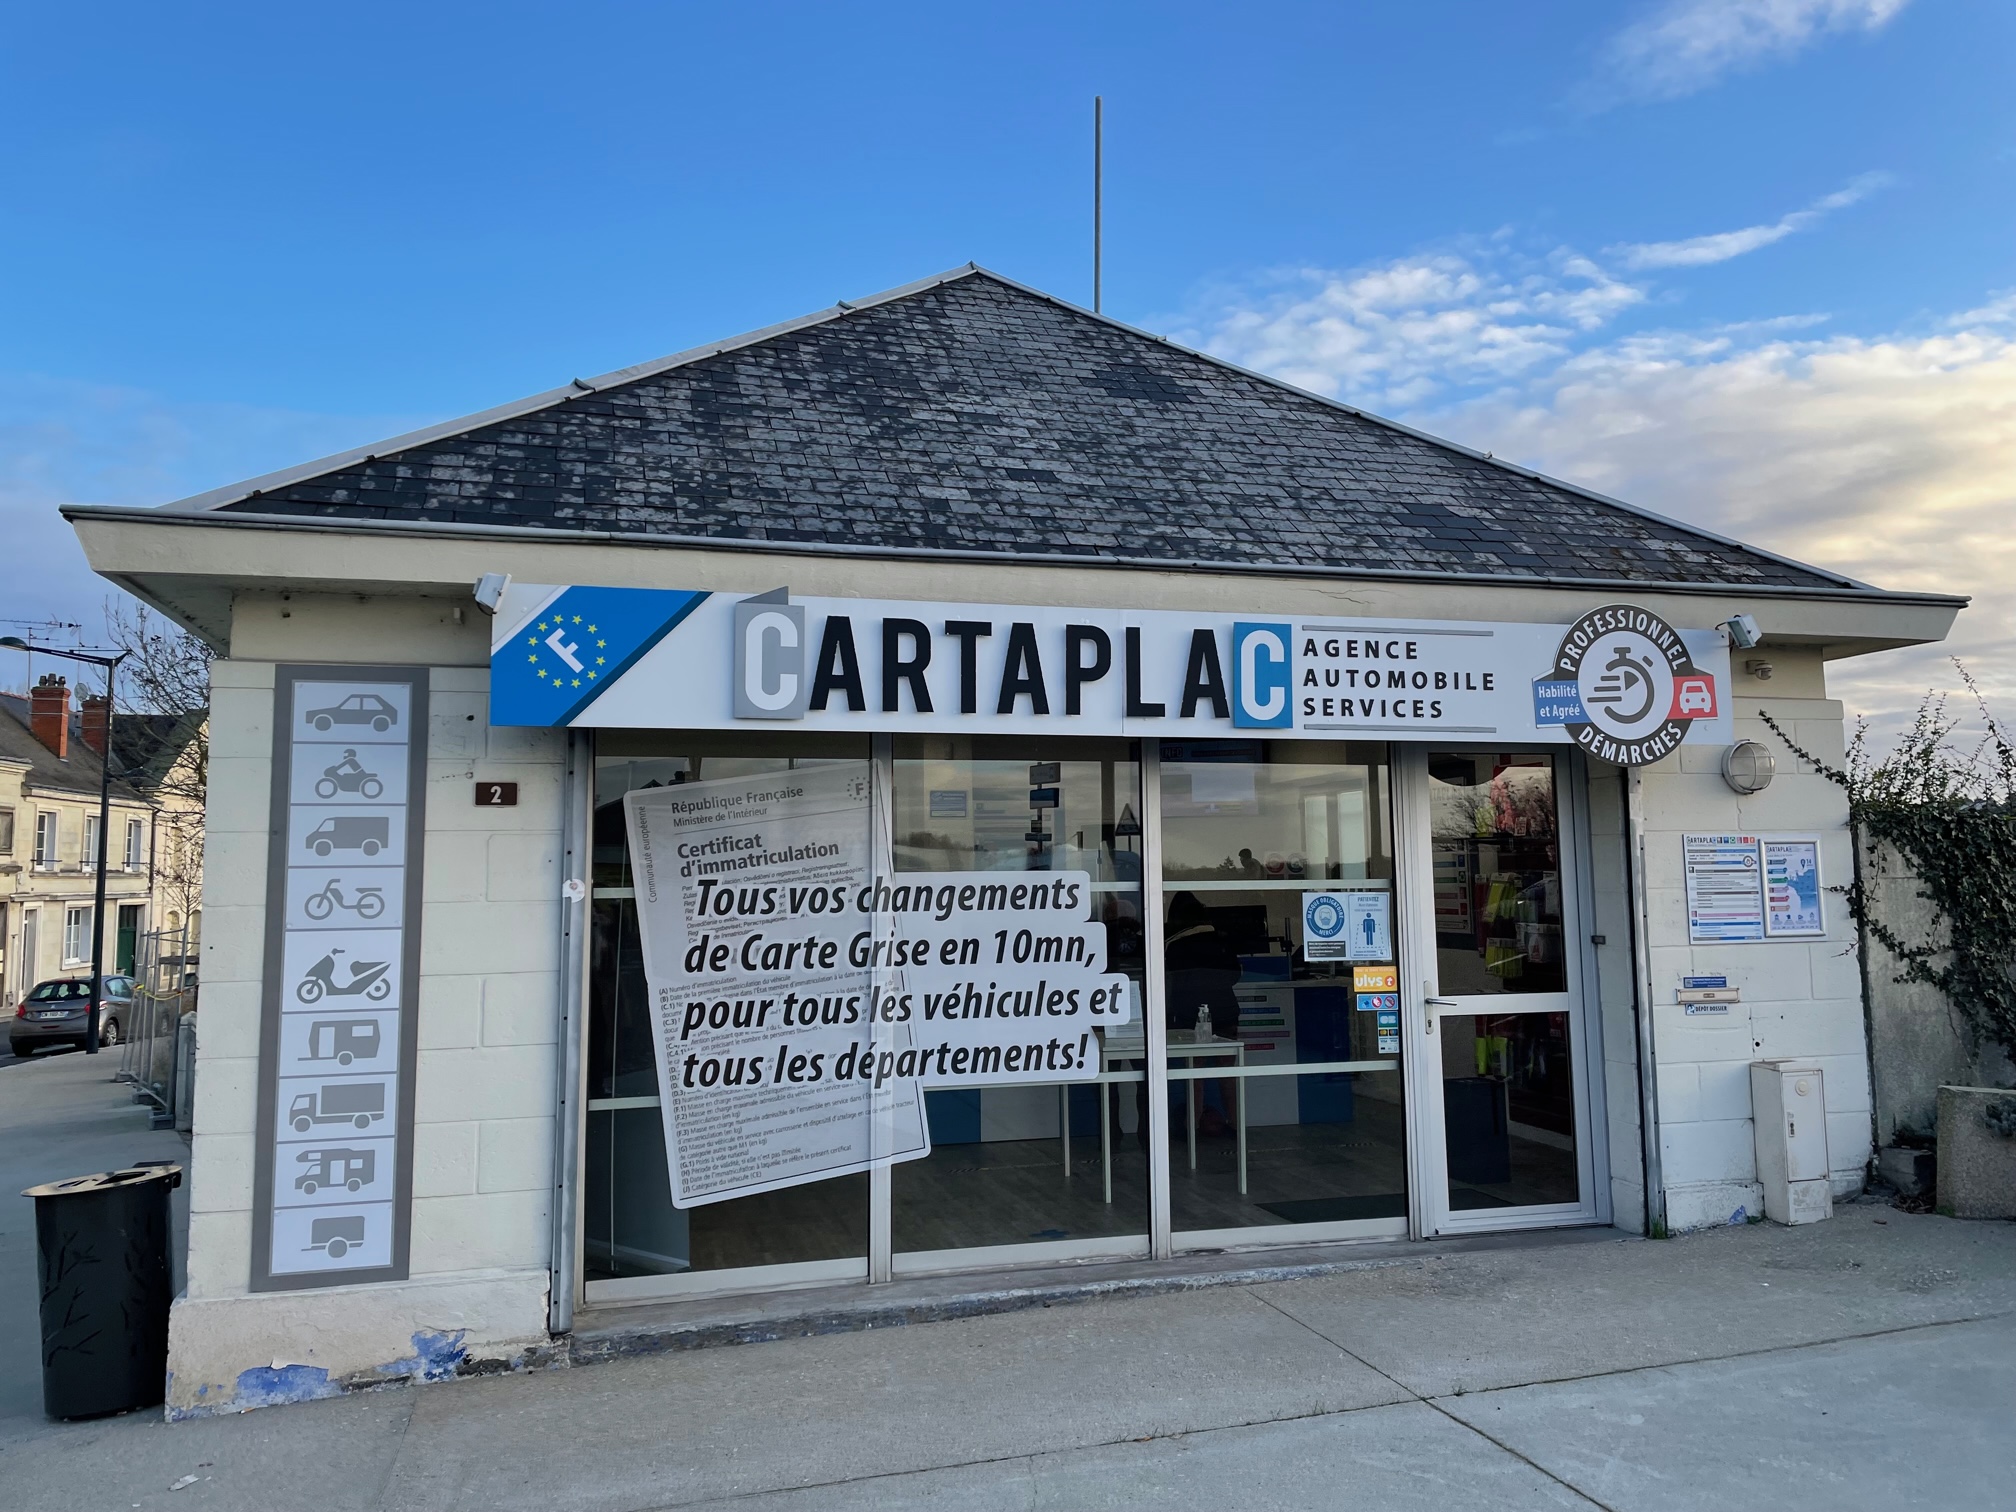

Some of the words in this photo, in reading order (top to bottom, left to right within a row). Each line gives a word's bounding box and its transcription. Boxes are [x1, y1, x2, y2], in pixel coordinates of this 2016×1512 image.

[544, 628, 584, 674] F
[1304, 637, 1418, 660] AGENCE
[1559, 607, 1689, 673] PROFESSIONNEL
[744, 611, 1285, 721] CARTAPLAC
[1304, 667, 1496, 692] AUTOMOBILE
[1538, 684, 1577, 698] Habilité
[1304, 696, 1443, 719] SERVICES
[1540, 705, 1550, 717] et
[1552, 703, 1580, 719] Agréé
[1578, 721, 1683, 764] DÉMARCHES
[490, 785, 501, 803] 2
[672, 795, 742, 814] République
[747, 786, 804, 803] Française
[855, 783, 864, 795] F
[639, 806, 650, 850] européenne
[674, 812, 713, 827] Ministère
[716, 812, 725, 821] de
[728, 807, 768, 819] l'Intérieur
[678, 834, 762, 858] Certificat
[681, 842, 839, 877] d'immatriculation
[645, 853, 657, 903] Communauté
[697, 879, 777, 916] Tous
[790, 886, 846, 914] vos
[857, 876, 1080, 921] changements
[1307, 900, 1320, 918] MASQUE
[1320, 898, 1344, 918] OBLIGATOIRE
[684, 934, 730, 973] de
[740, 934, 838, 971] Carte
[848, 931, 930, 967] Grise
[940, 939, 979, 965] en
[994, 930, 1096, 968] 10mn,
[659, 988, 668, 996] (A)
[670, 985, 690, 993] Numéro
[698, 986, 720, 998] première
[722, 980, 761, 992] immatriculation
[770, 975, 791, 984] véhicule
[1355, 974, 1383, 987] ulys
[680, 998, 775, 1040] pour
[784, 992, 860, 1026] tous
[870, 986, 912, 1023] les
[923, 981, 1079, 1021] véhicules
[1090, 983, 1122, 1015] et
[683, 1053, 763, 1088] tous
[774, 1045, 824, 1084] les
[835, 1034, 1088, 1089] départements!
[678, 1145, 688, 1153] (G)
[715, 1136, 735, 1146] véhicule
[692, 1181, 717, 1191] Catégorie
[727, 1174, 749, 1183] véhicule
[750, 1171, 762, 1180] (CE)
